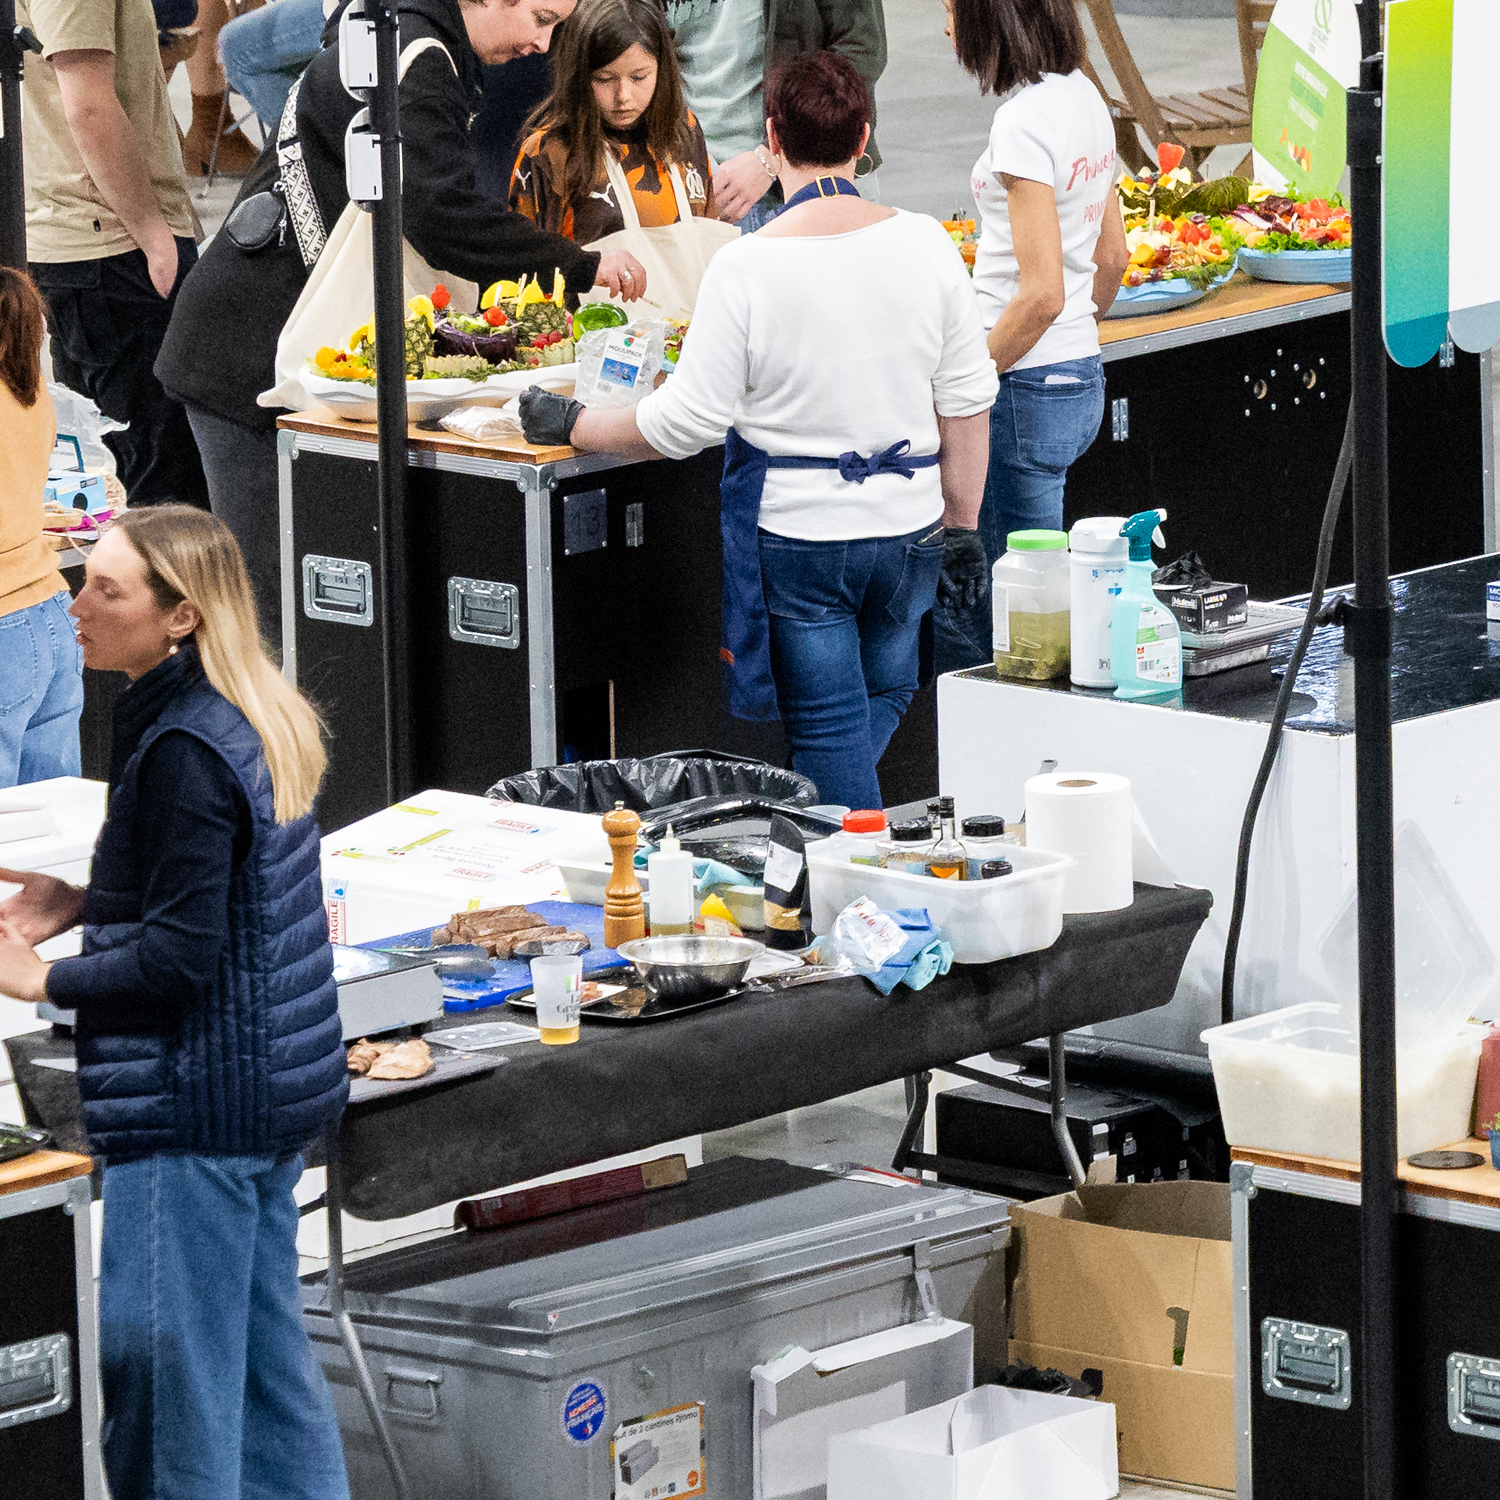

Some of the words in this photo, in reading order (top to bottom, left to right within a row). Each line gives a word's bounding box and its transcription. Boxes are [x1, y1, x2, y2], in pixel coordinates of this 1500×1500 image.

[627, 1428, 638, 1437] de
[639, 1425, 645, 1436] 2
[645, 1418, 674, 1433] cantines
[676, 1412, 698, 1424] Promo
